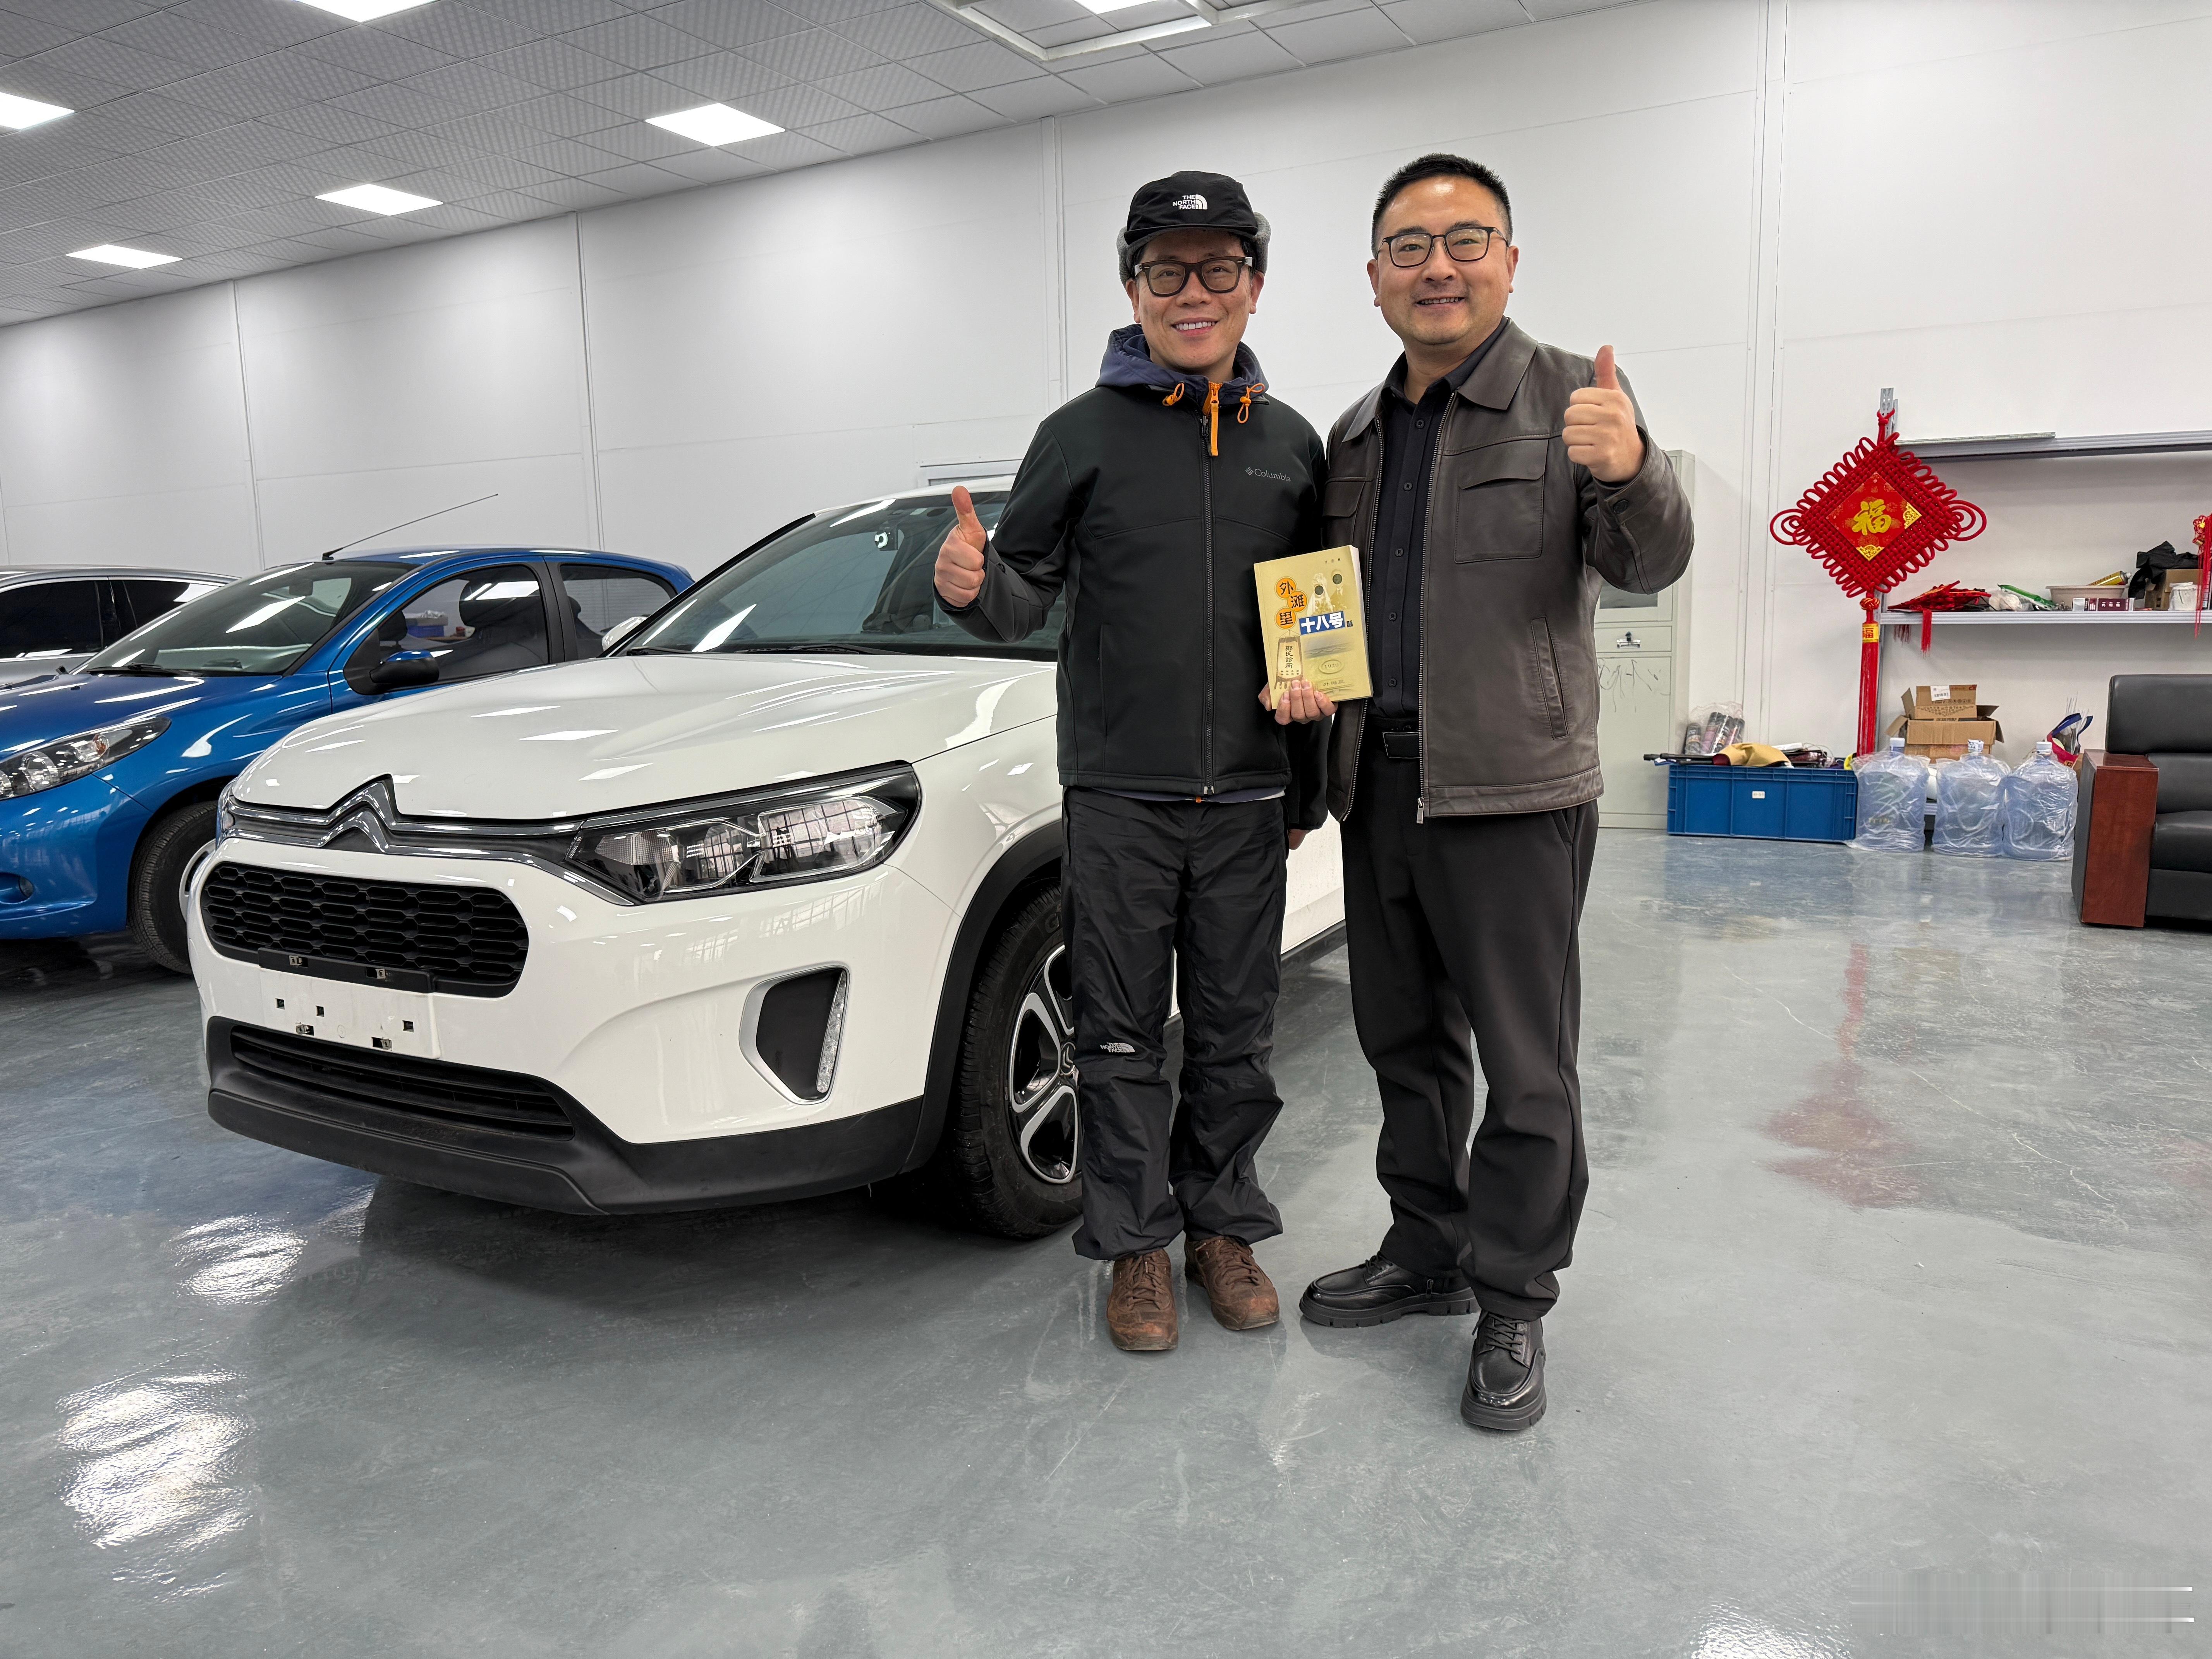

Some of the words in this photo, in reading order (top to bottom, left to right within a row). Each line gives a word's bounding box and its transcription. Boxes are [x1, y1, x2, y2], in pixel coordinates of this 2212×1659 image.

[1254, 469, 1291, 482] Columbia
[1851, 499, 1892, 536] 福
[1301, 612, 1343, 633] 十八号
